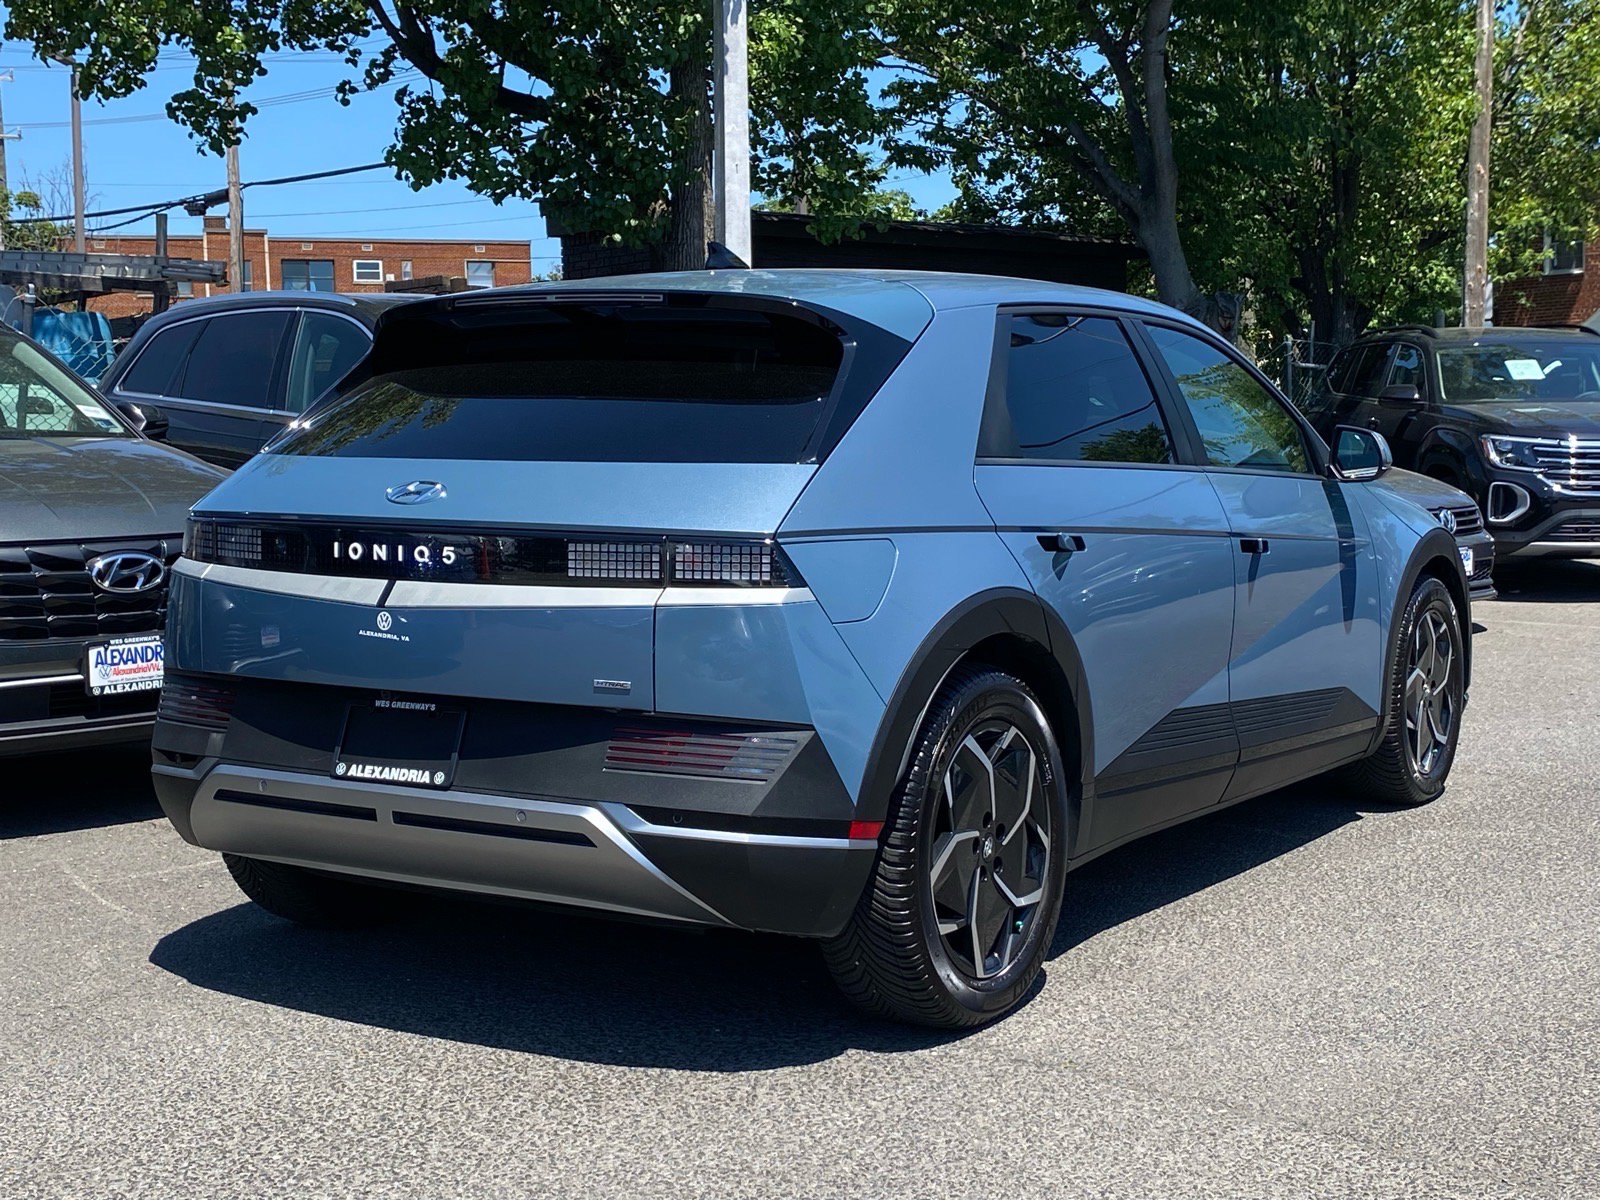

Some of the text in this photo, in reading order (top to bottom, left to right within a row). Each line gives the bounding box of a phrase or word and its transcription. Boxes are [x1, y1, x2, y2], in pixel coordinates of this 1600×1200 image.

[333, 541, 456, 565] IONIQ 5
[359, 630, 400, 640] ALEXANDRIA,
[103, 680, 162, 694] ALEXANDRI
[375, 700, 436, 711] WES GREENWAY'S
[347, 764, 430, 783] ALEXANDRIA
